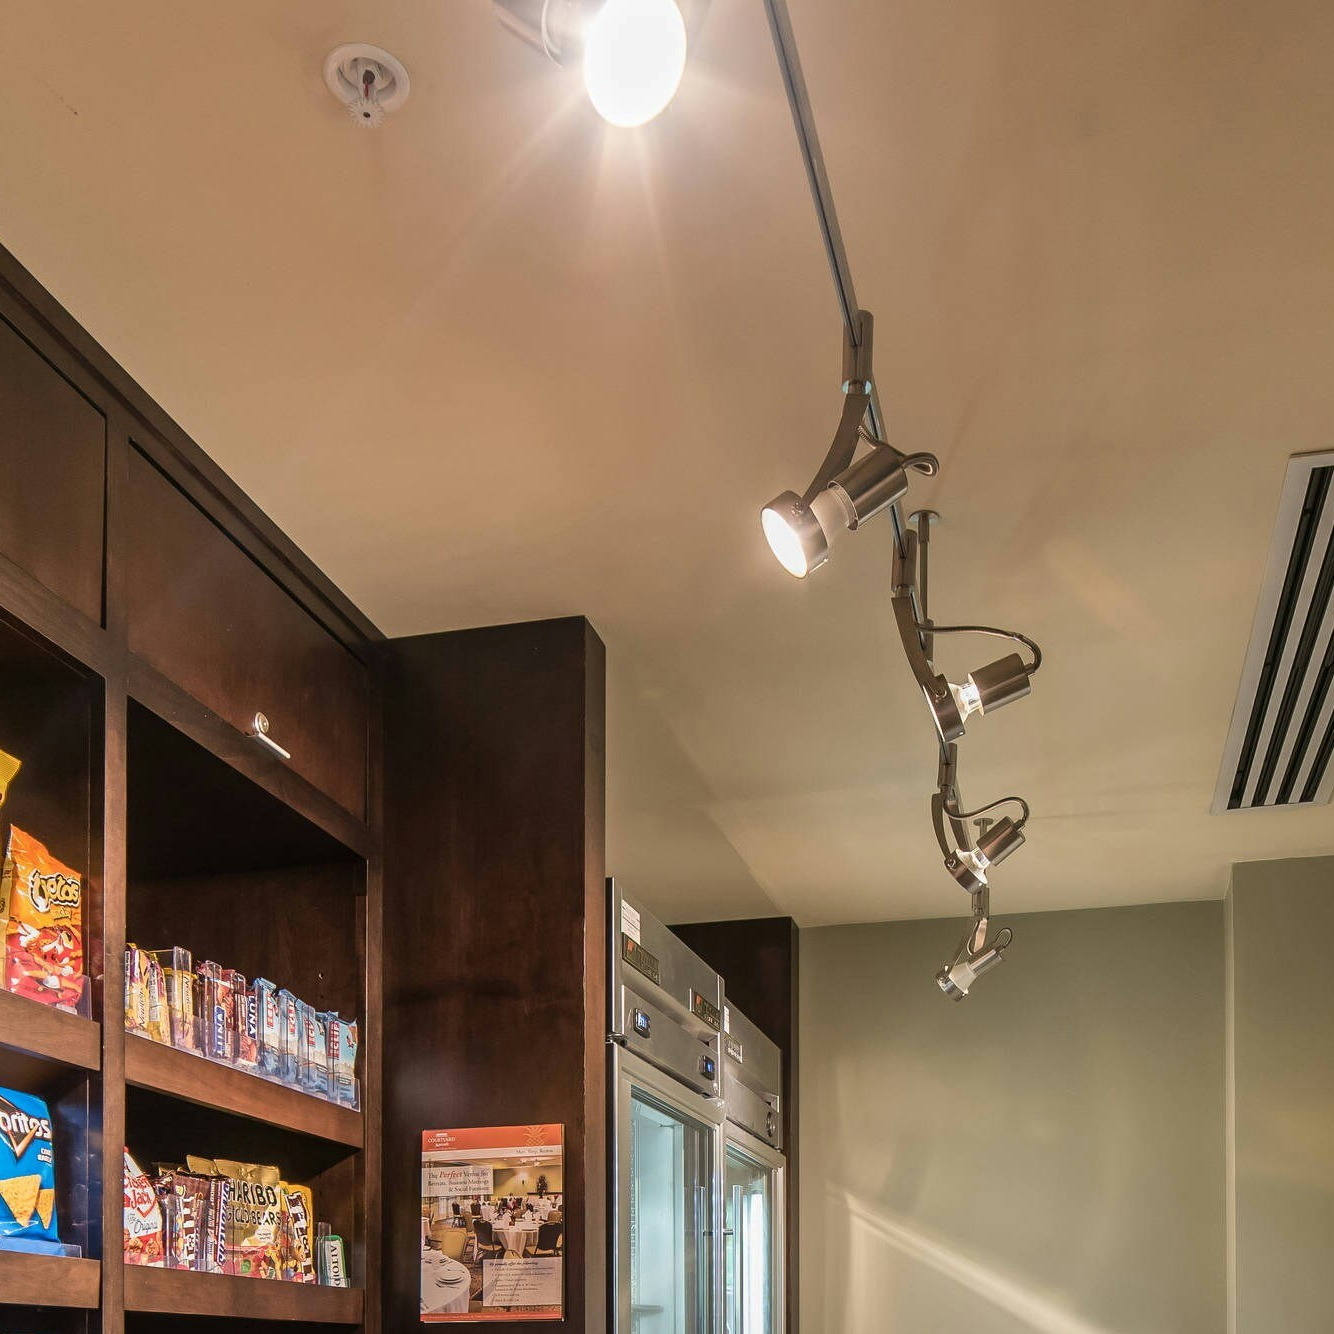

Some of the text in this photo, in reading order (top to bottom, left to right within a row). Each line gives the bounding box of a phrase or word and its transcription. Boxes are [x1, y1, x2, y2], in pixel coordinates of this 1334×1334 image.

[248, 995, 257, 1035] LUNA
[439, 1170, 463, 1180] Perfect
[228, 1178, 278, 1208] HARIBO
[330, 1244, 341, 1287] ALTOID
